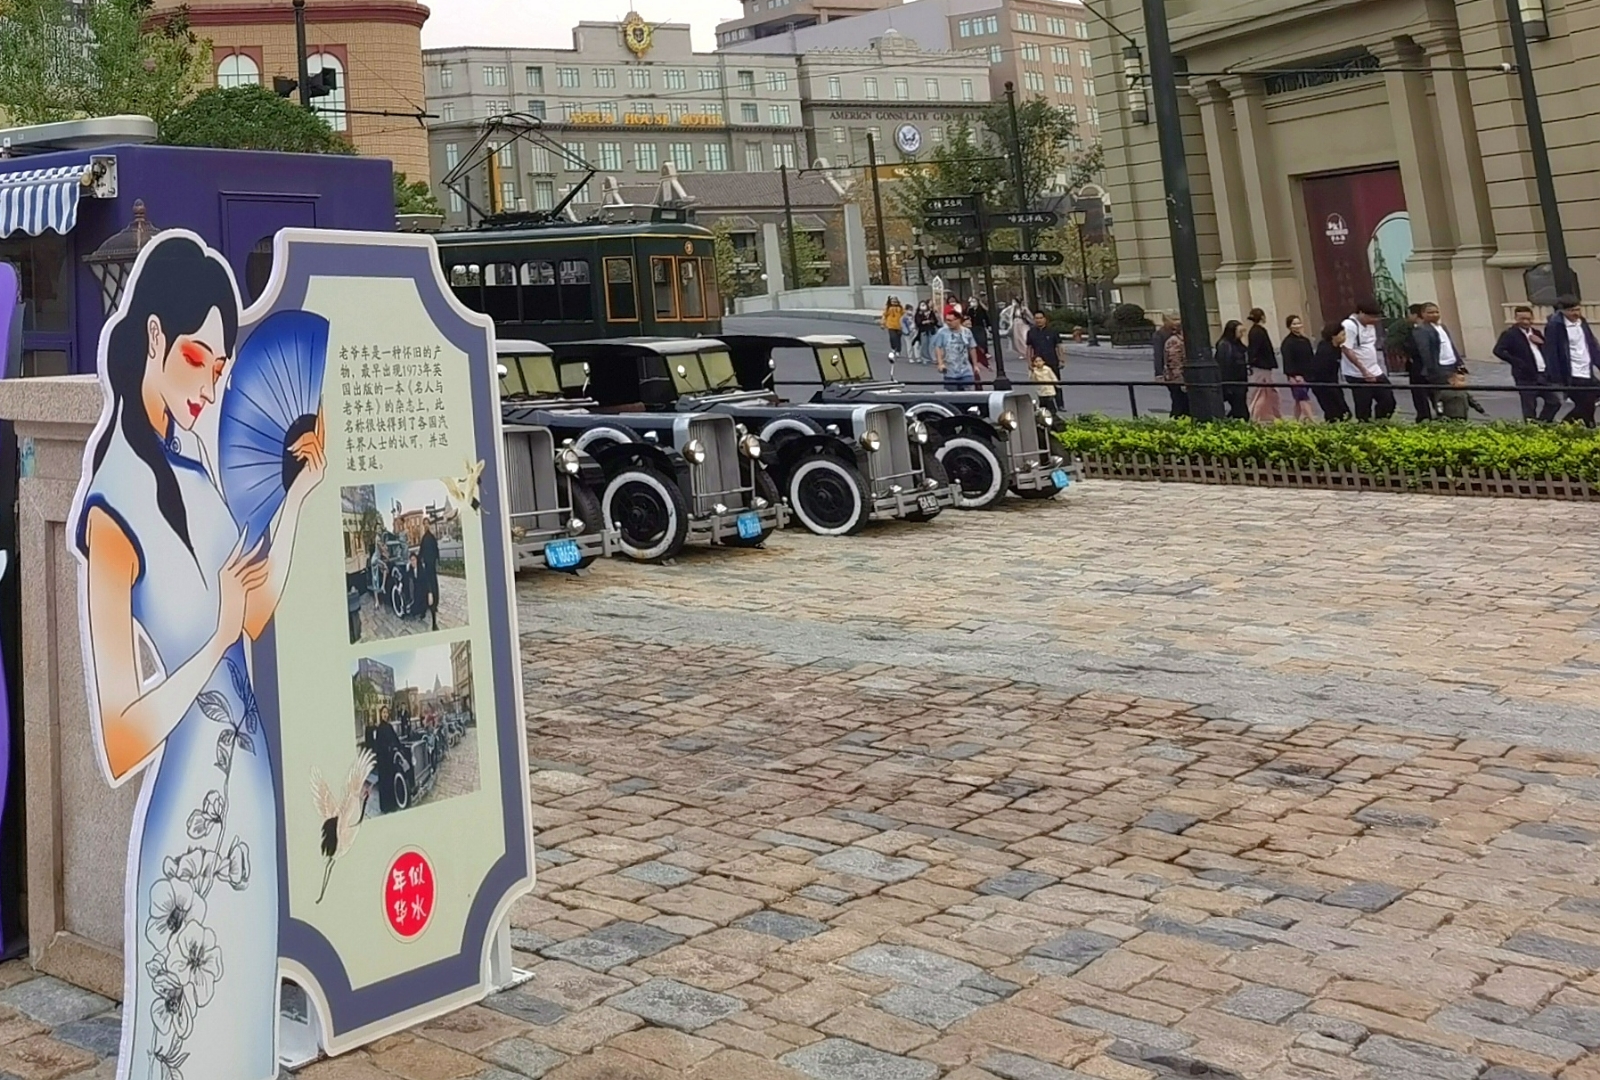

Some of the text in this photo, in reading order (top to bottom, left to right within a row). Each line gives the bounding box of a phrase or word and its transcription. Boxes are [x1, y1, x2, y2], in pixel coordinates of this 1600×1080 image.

[339, 344, 443, 360] 老爷车是一种怀旧的产
